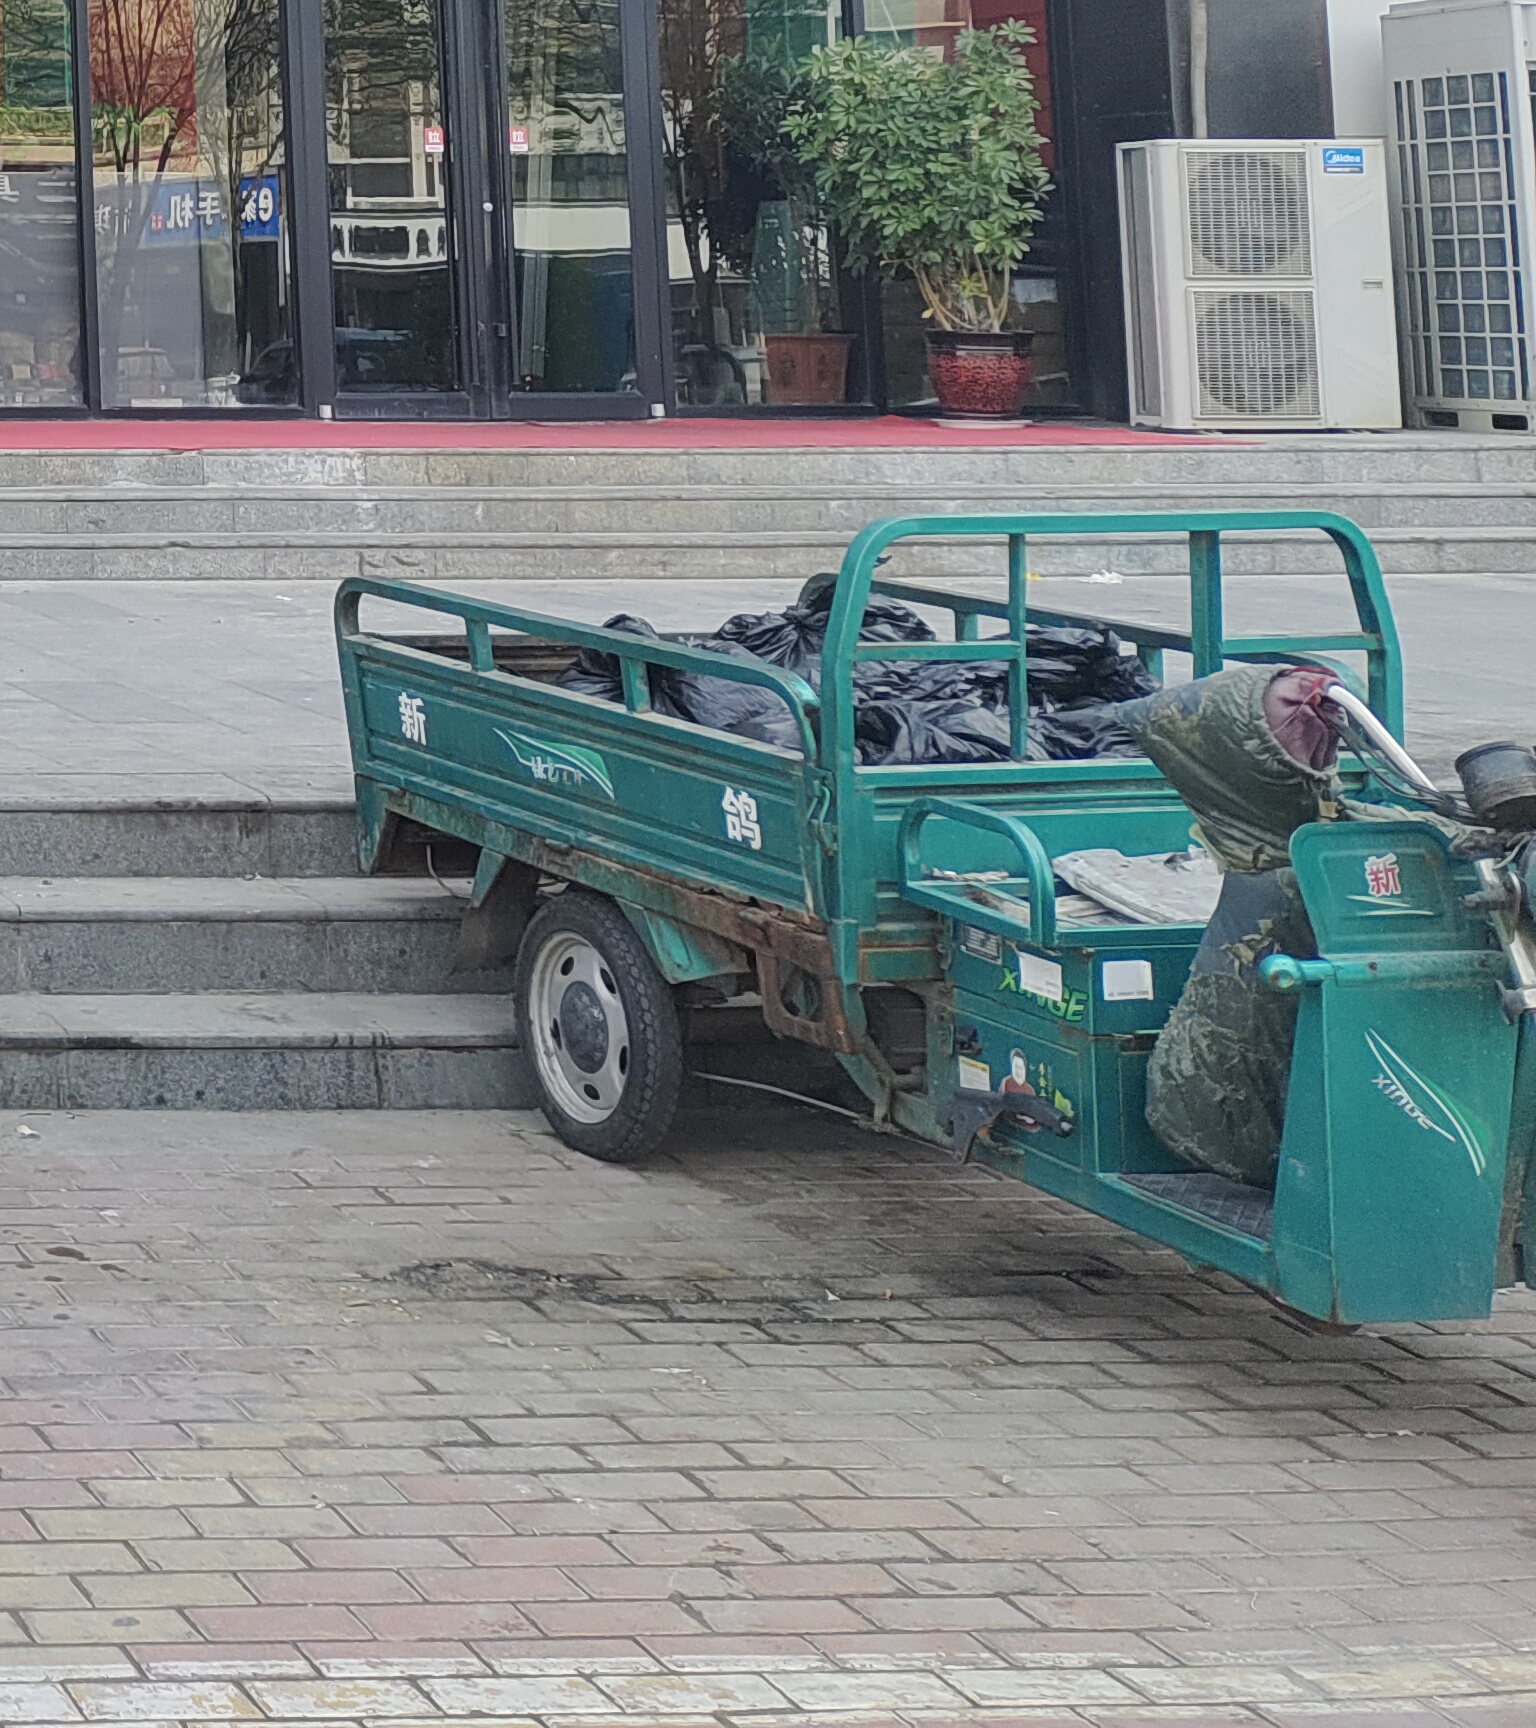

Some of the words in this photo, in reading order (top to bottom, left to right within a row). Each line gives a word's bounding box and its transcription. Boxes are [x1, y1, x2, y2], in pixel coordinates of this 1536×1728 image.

[398, 692, 427, 746] 新
[722, 786, 761, 850] 鸽
[1364, 853, 1401, 897] 新
[998, 967, 1088, 1021] XGE
